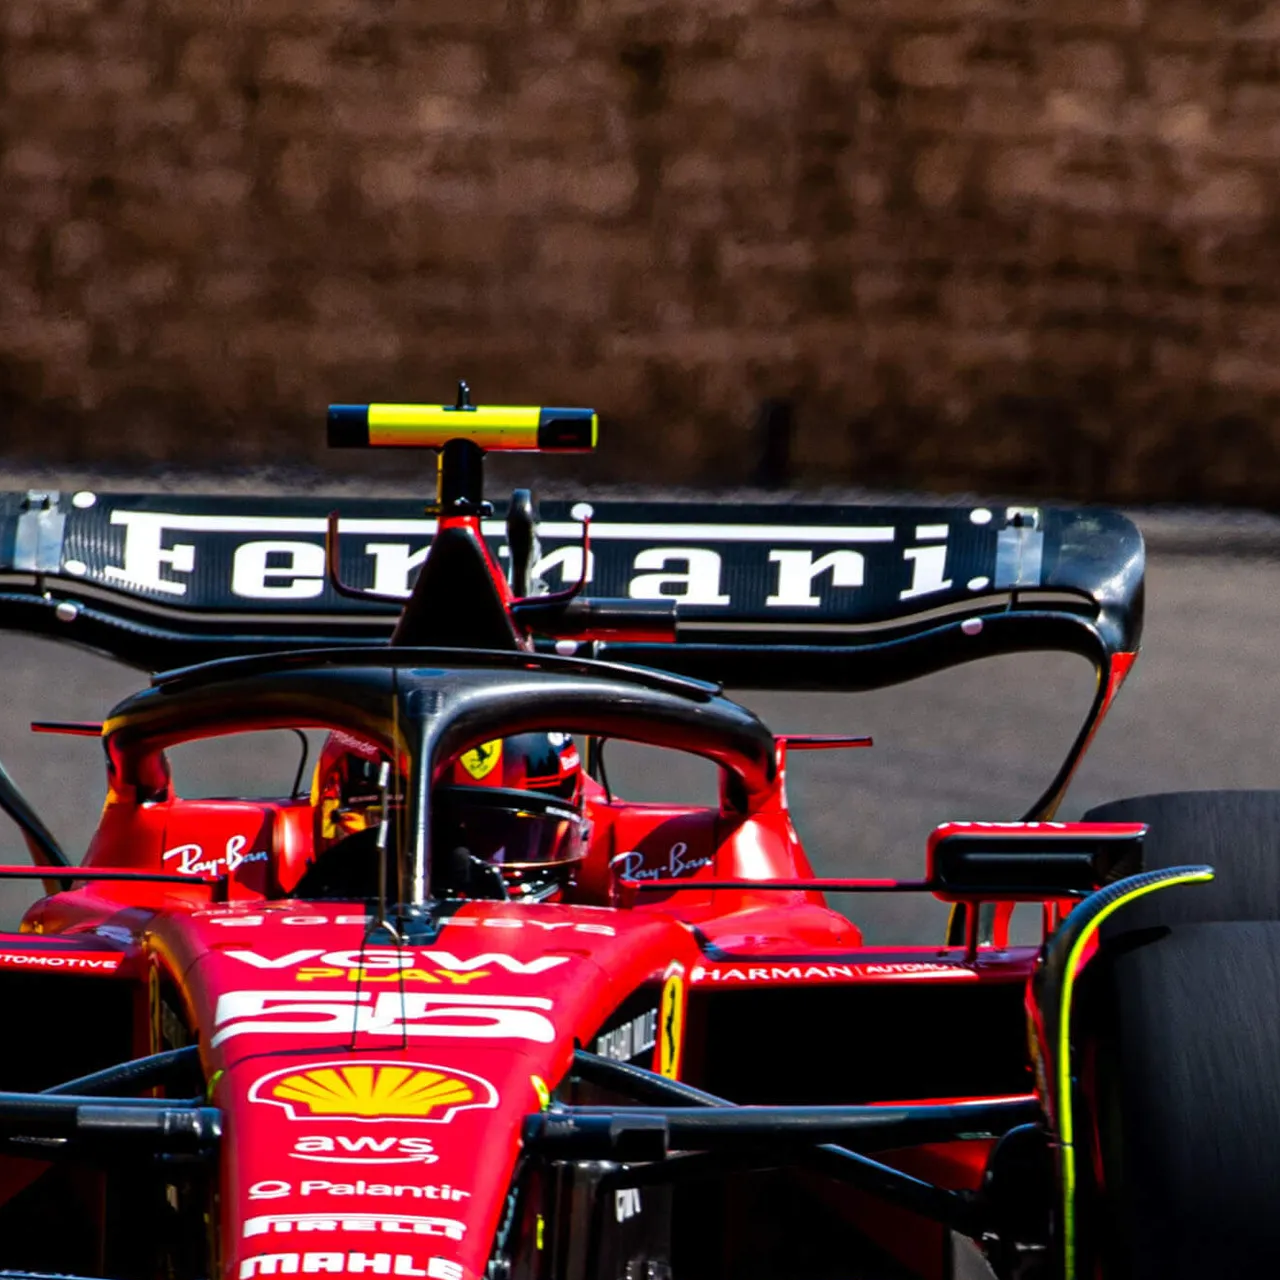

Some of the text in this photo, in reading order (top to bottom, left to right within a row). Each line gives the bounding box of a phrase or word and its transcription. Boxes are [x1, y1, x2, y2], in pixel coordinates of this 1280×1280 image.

[163, 835, 268, 876] Ray-Ban
[608, 842, 714, 881] Ray-Ban
[222, 949, 571, 974] VGW
[697, 965, 853, 981] HARMAN
[295, 967, 492, 984] PLAY
[211, 990, 556, 1048] 55
[294, 1136, 434, 1153] aws
[300, 1180, 471, 1201] Palantir
[243, 1213, 467, 1240] PIRELLI
